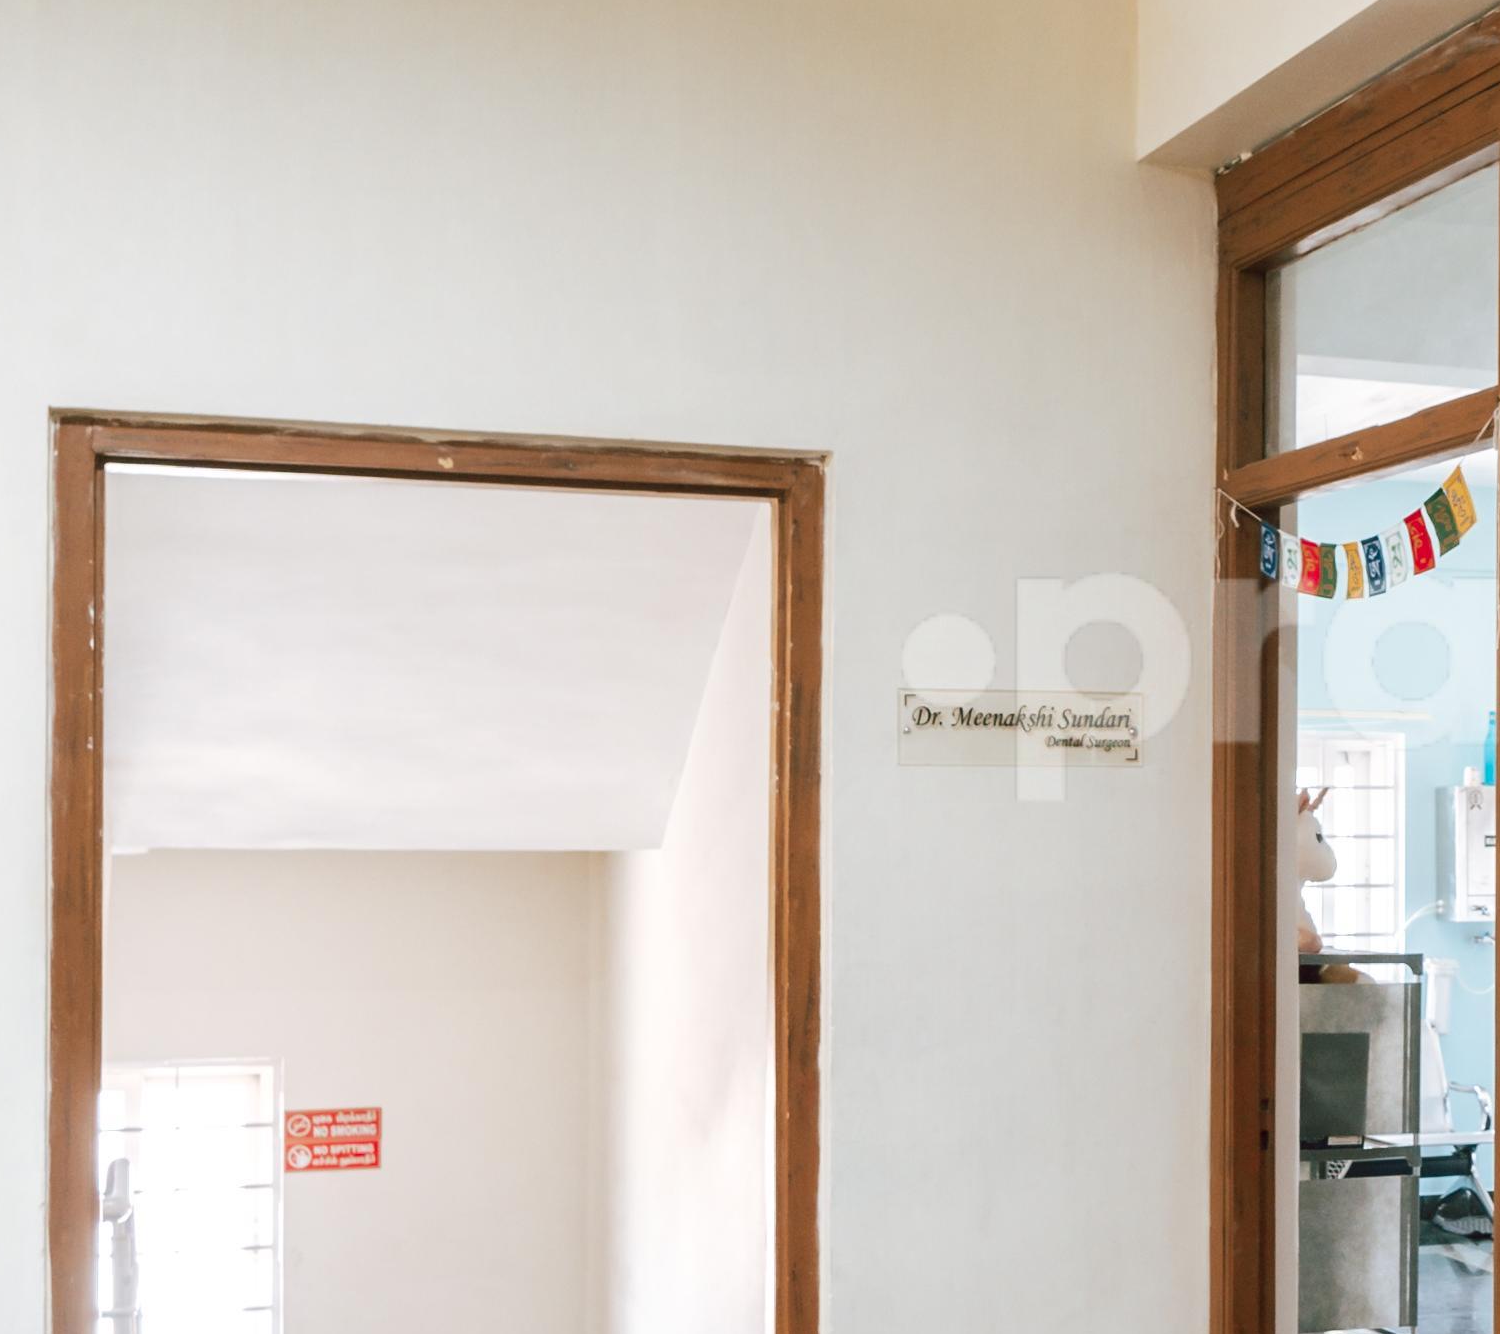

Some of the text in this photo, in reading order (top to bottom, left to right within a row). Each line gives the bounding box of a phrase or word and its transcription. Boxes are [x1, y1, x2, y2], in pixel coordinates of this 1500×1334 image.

[911, 705, 1133, 733] Dr. Meenakshi Sundari
[1046, 734, 1132, 752] Dental Surgeon
